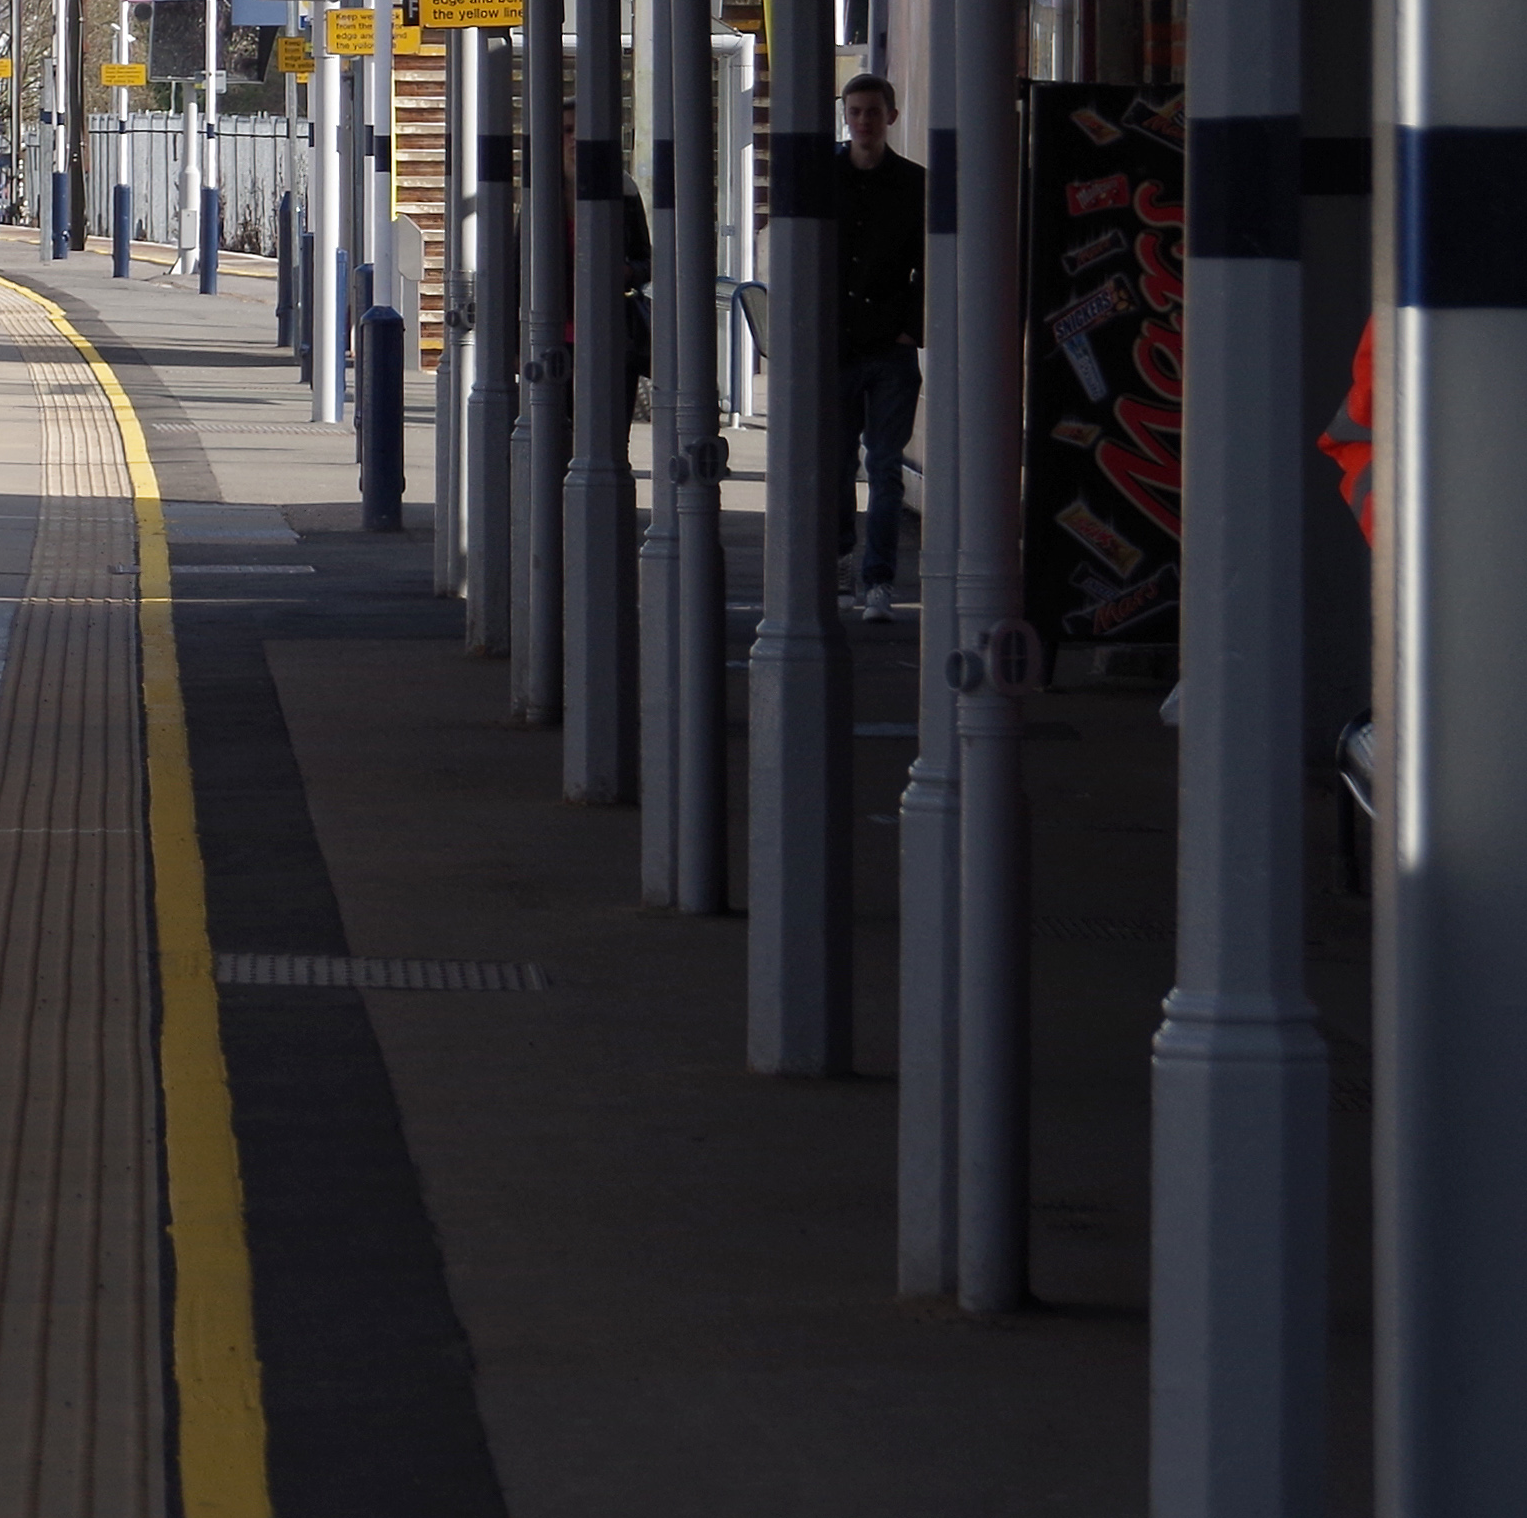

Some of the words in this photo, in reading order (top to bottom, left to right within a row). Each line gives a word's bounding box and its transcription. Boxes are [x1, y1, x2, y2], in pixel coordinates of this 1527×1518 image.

[433, 9, 454, 20] the
[458, 8, 499, 21] yellow
[1054, 289, 1113, 342] SNICKERS
[1093, 581, 1159, 635] Mars
